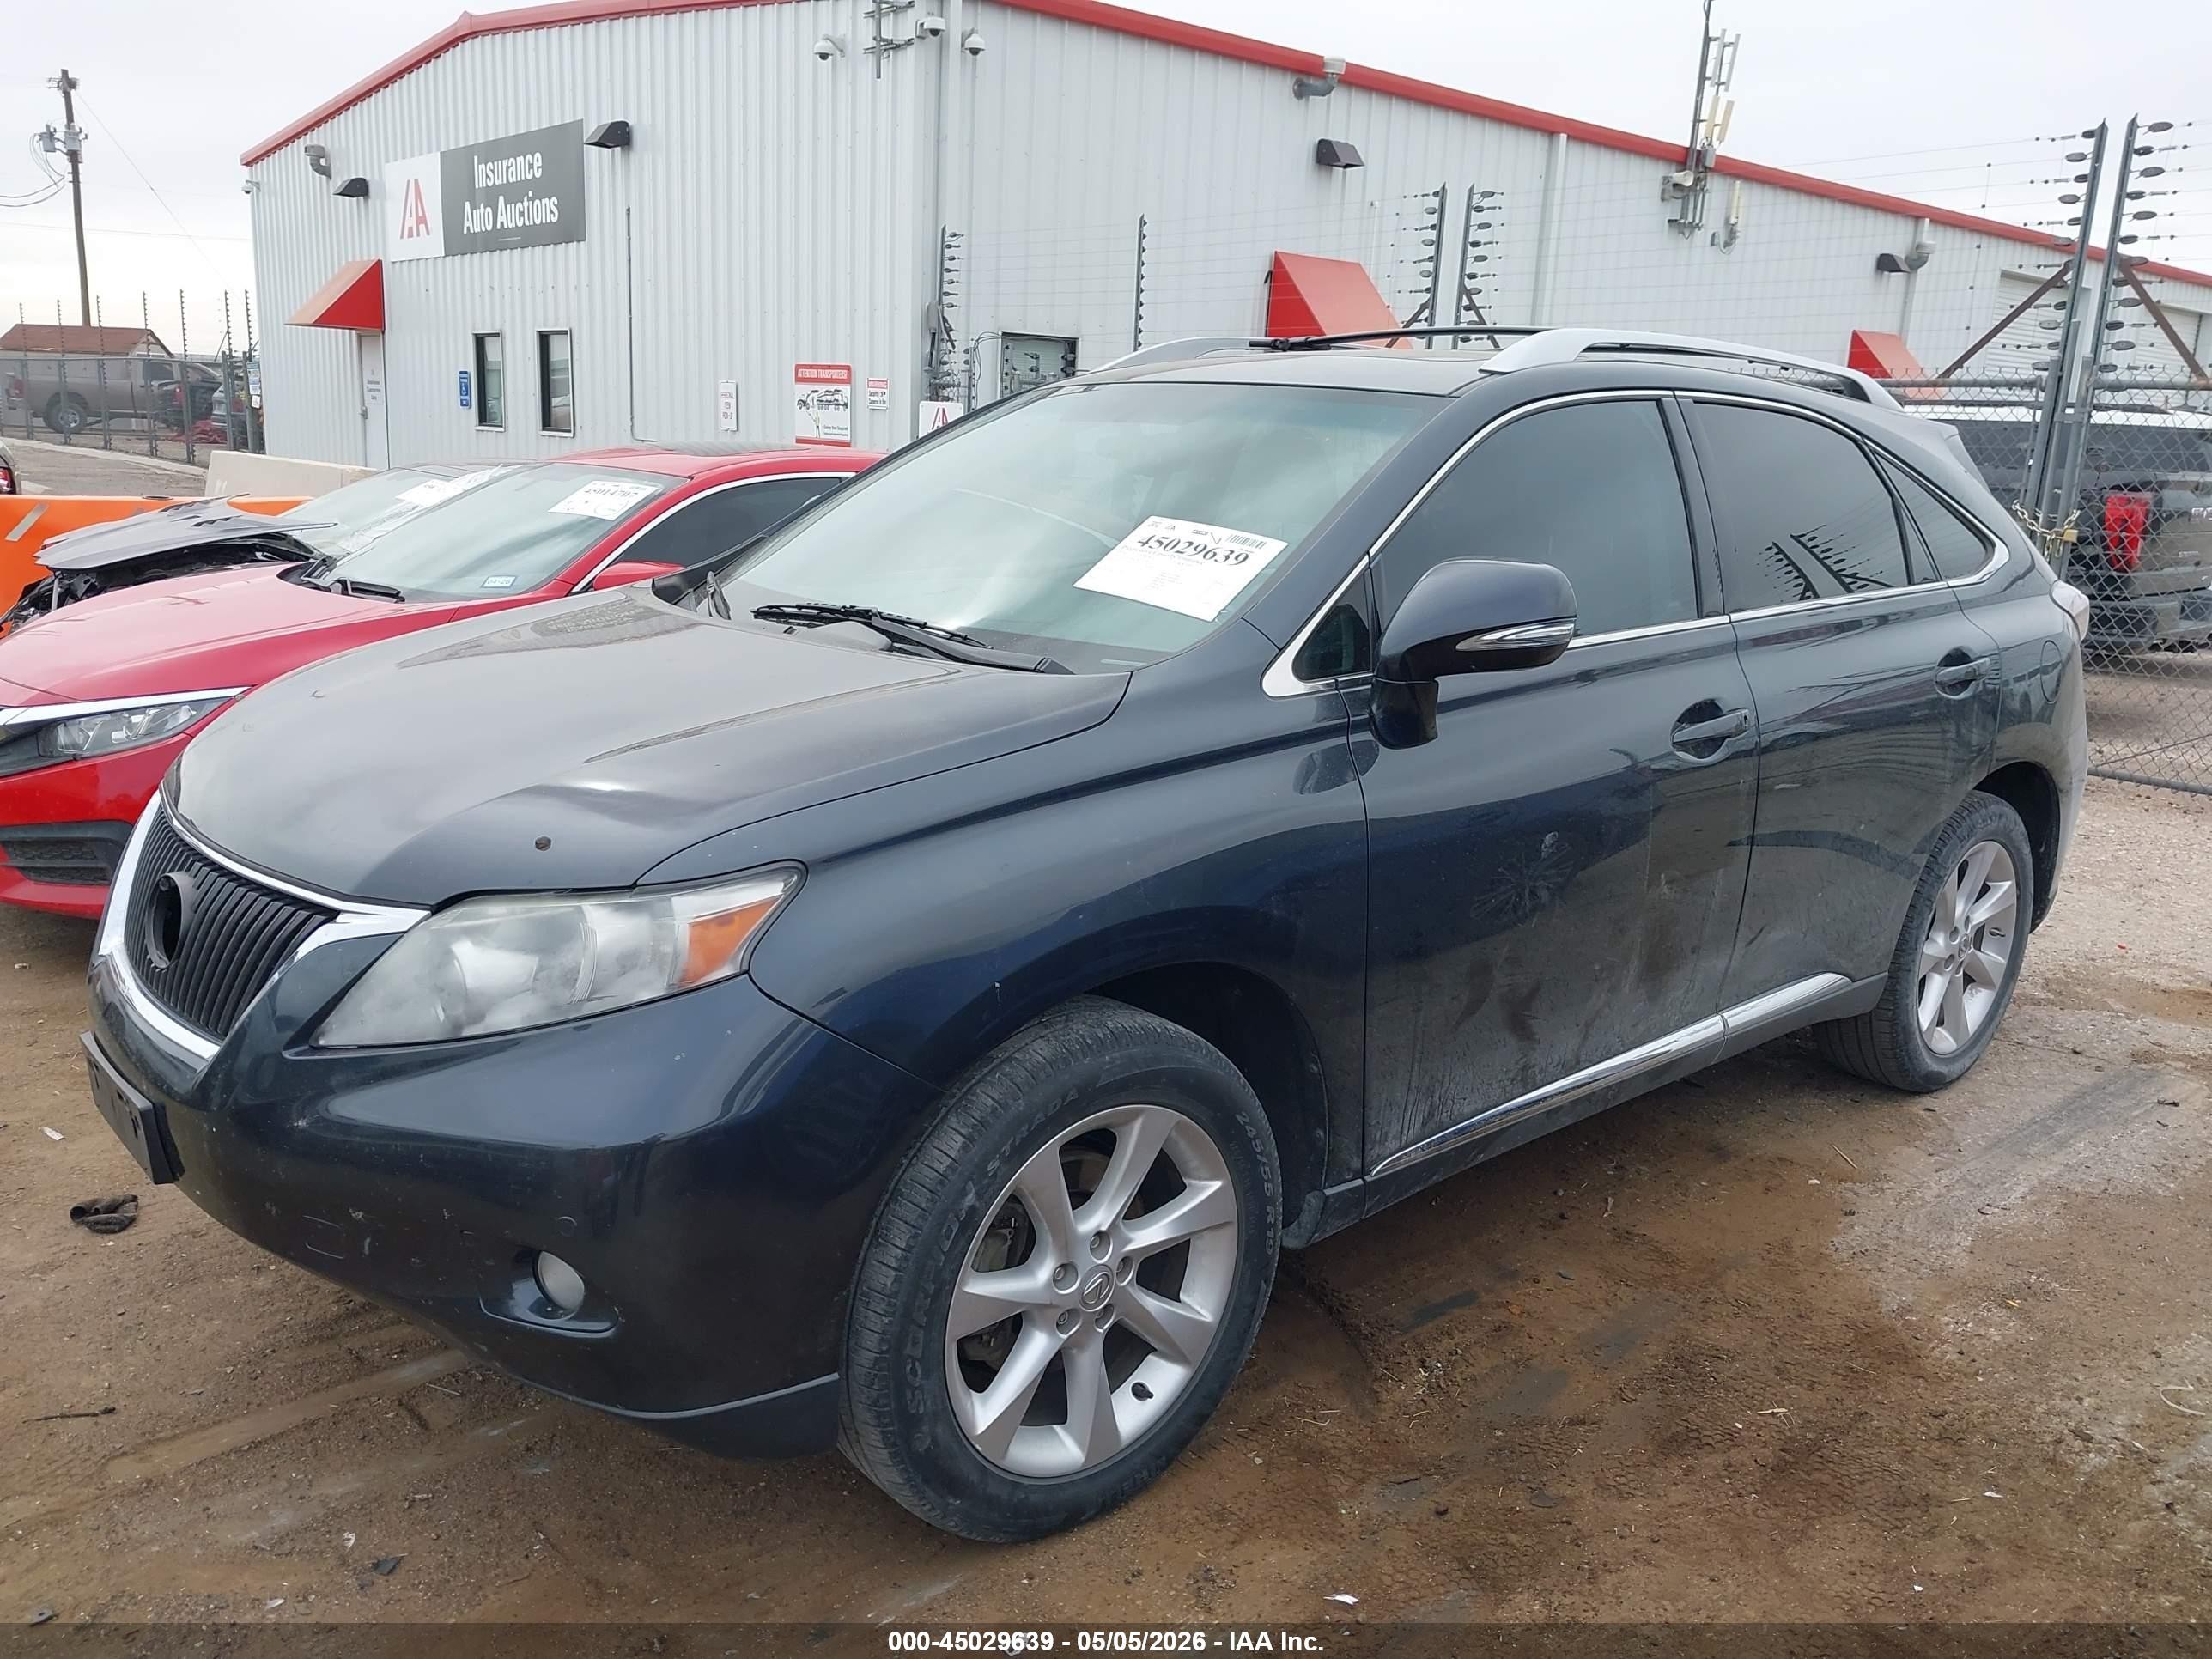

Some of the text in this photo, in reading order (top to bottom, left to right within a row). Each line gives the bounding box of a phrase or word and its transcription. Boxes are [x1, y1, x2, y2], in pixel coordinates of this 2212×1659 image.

[473, 151, 543, 189] Insurance
[463, 191, 559, 234] Auto Auctions
[1137, 534, 1250, 567] 45029639
[1233, 1110, 1274, 1198] 245/55
